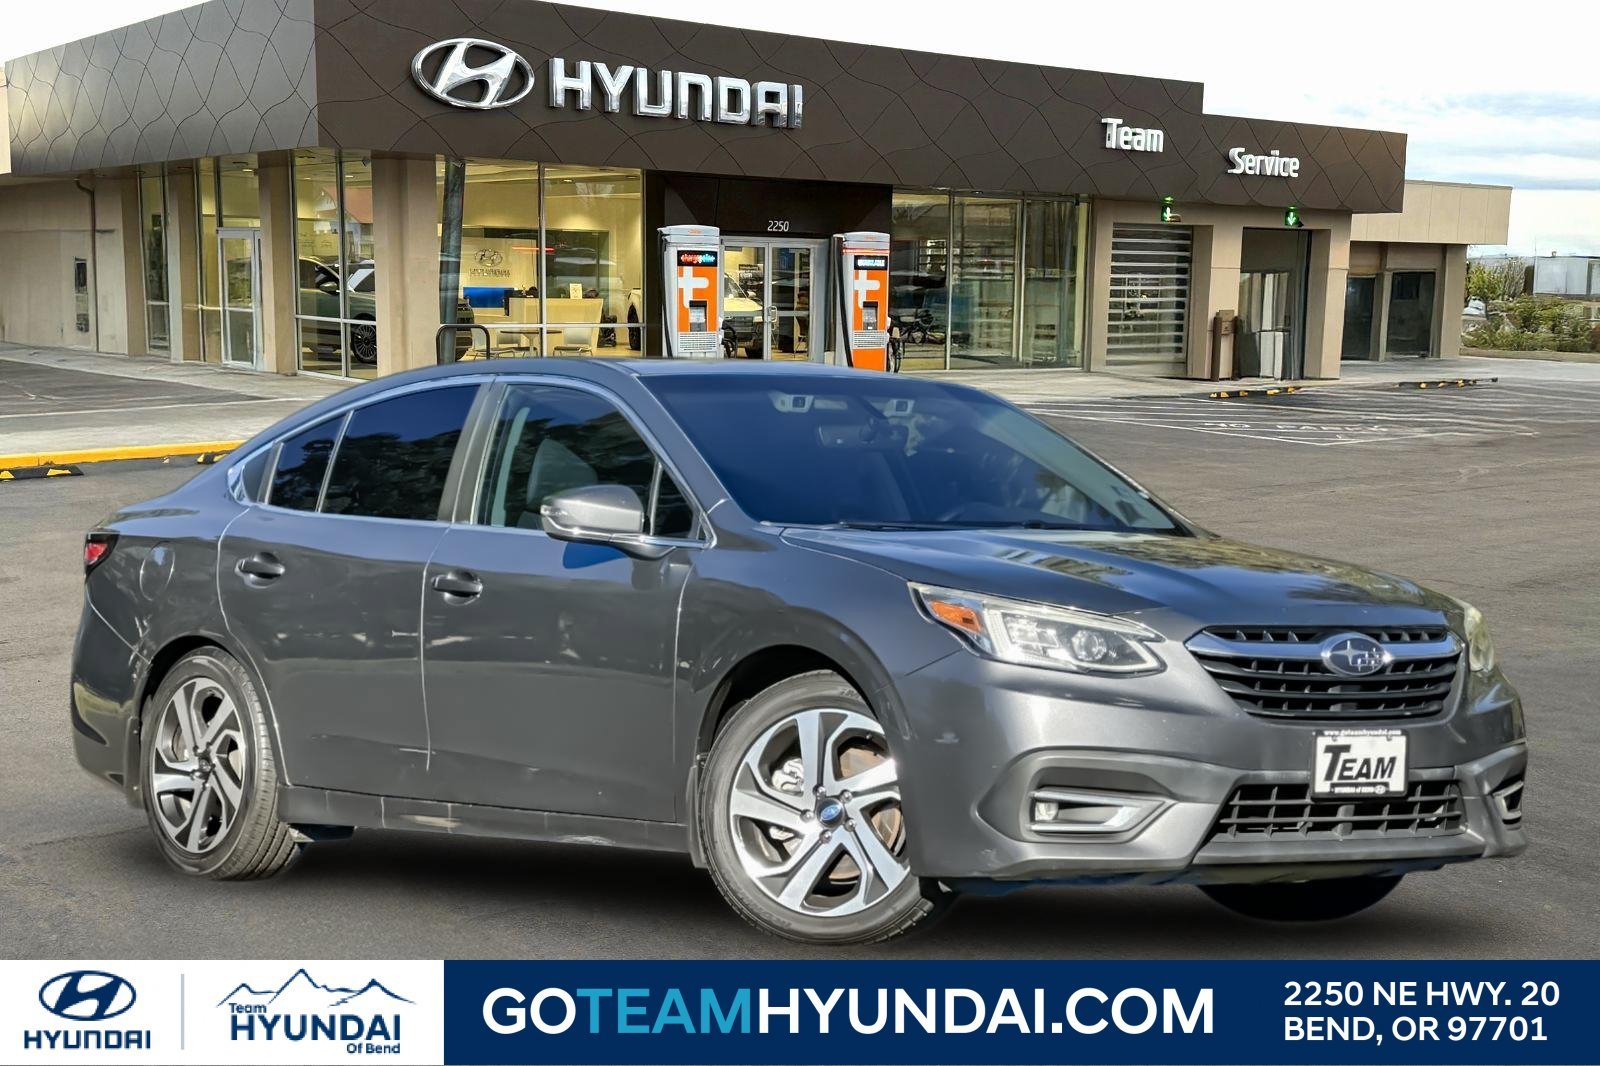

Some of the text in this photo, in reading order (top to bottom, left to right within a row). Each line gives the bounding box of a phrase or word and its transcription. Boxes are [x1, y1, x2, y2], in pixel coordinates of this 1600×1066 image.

[549, 57, 803, 129] HYUNDAI
[1101, 117, 1164, 153] Team
[1227, 147, 1300, 178] Service
[767, 220, 790, 232] 2250
